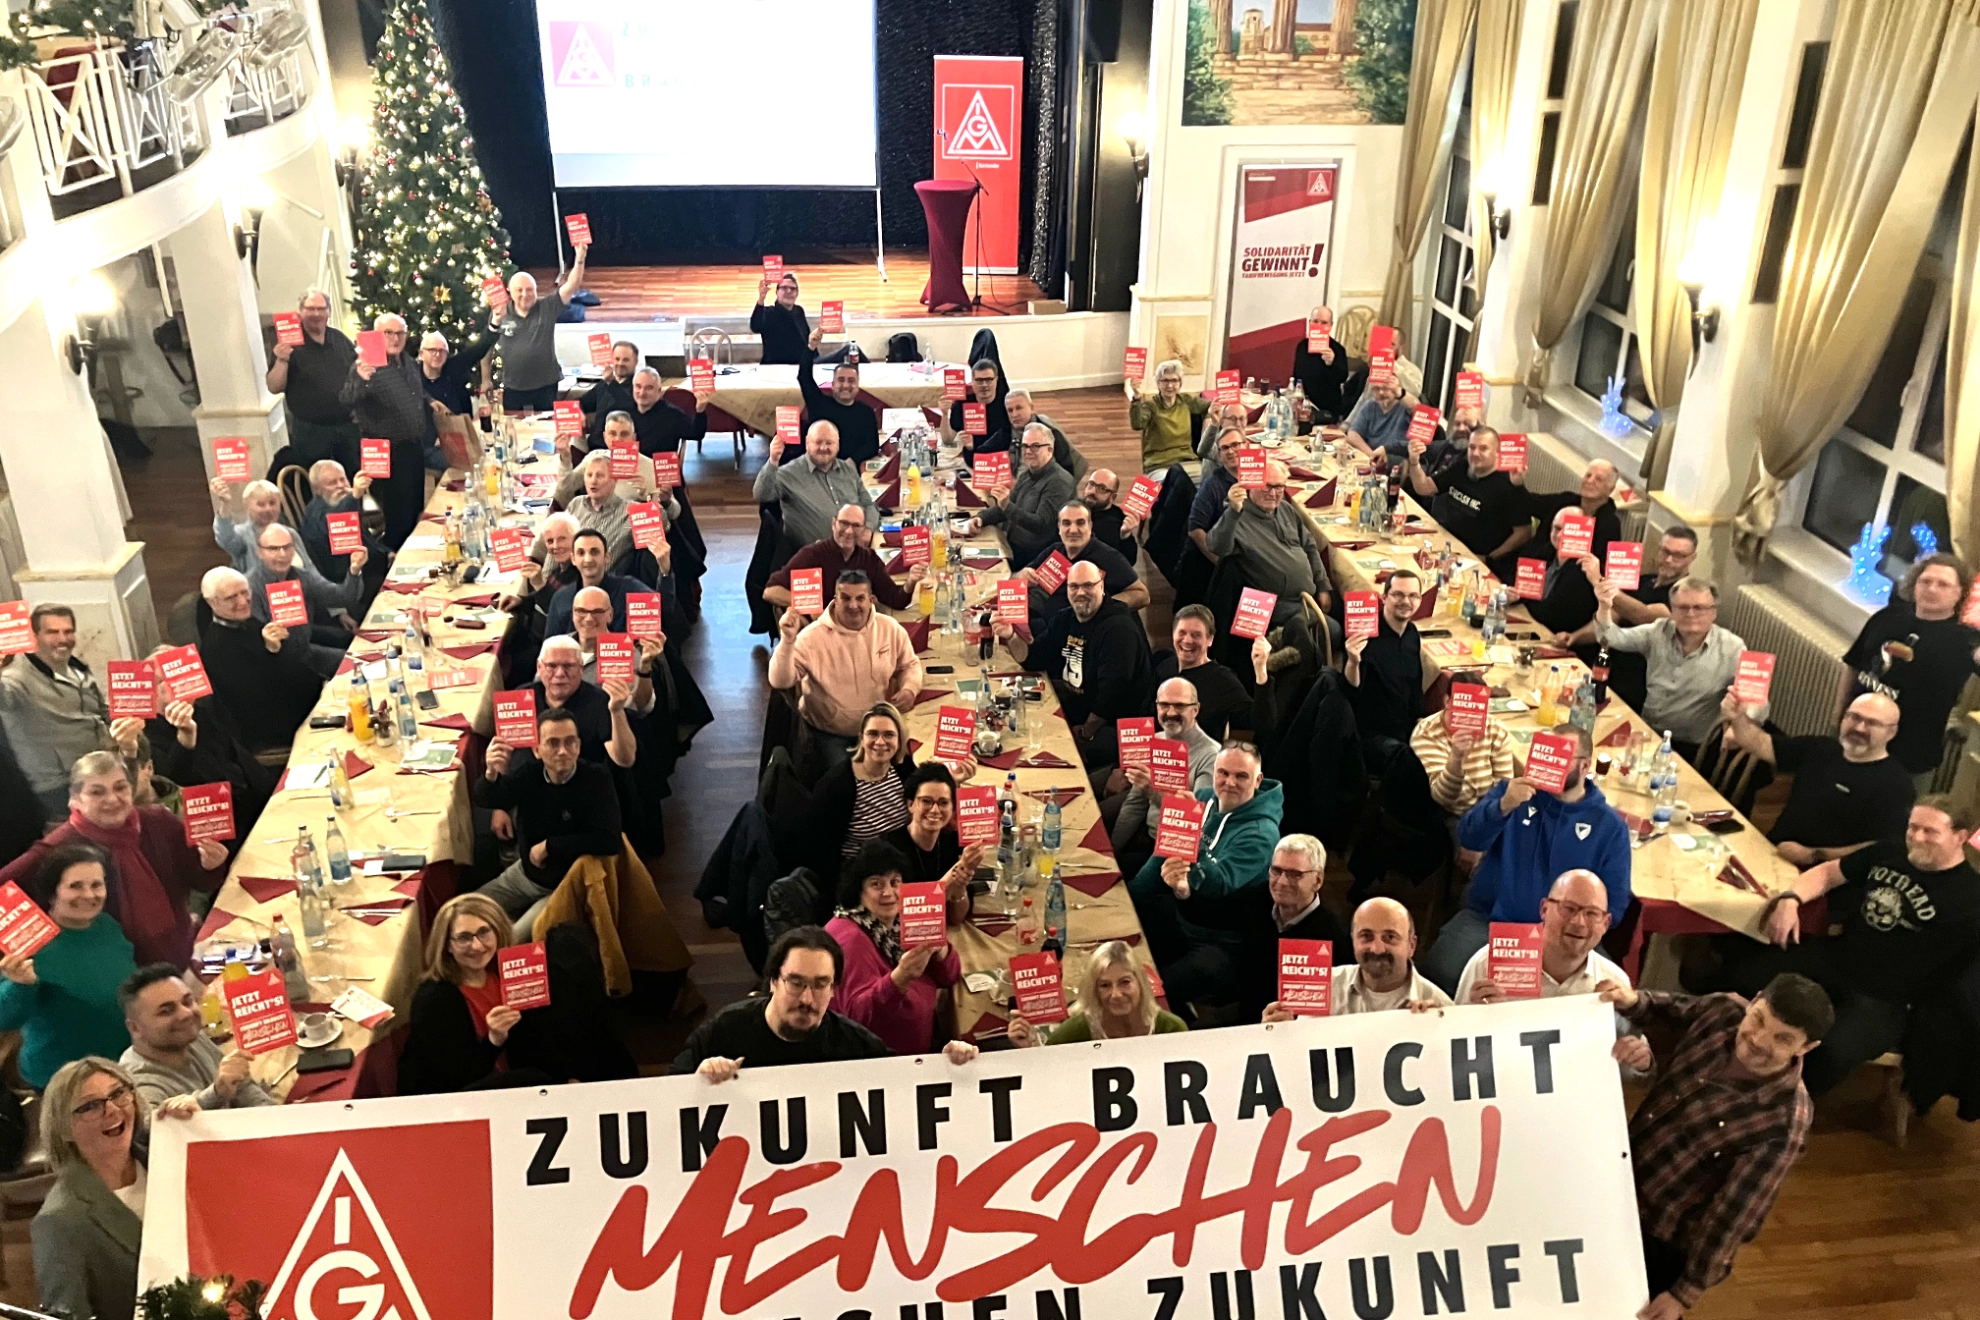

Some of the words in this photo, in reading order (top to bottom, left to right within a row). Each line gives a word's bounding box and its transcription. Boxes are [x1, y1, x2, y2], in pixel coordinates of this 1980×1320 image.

[1243, 243, 1311, 257] SOLIDARITÄT
[526, 1075, 1023, 1187] ZUKUNFT
[1092, 1029, 1561, 1133] BRAUCHT
[569, 1105, 1501, 1320] MENSCHEN
[1147, 1238, 1584, 1320] ZUKUNFT
